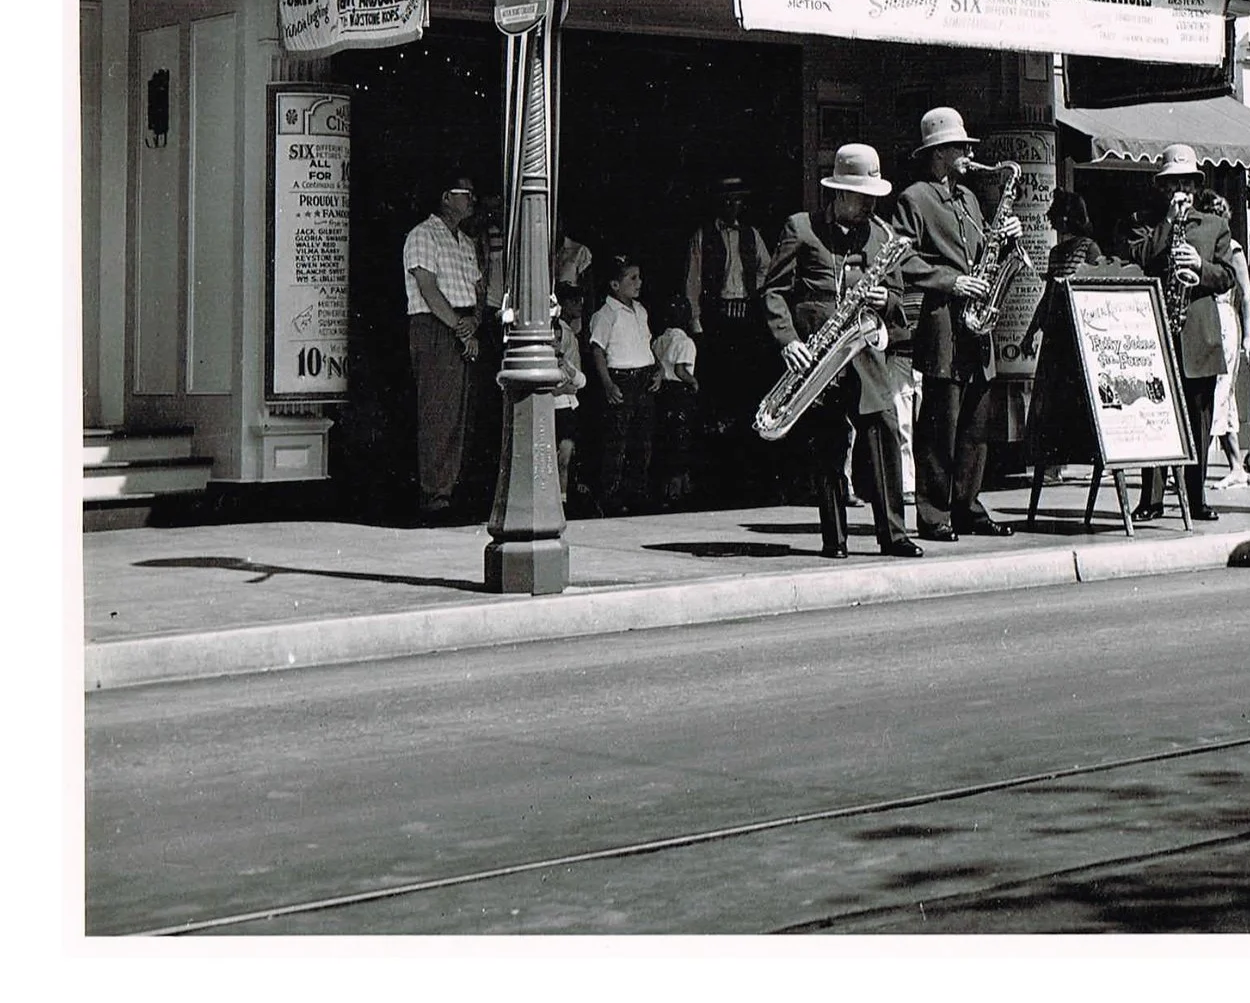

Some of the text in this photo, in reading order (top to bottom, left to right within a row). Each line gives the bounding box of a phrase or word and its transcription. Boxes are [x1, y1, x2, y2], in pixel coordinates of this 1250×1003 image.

[289, 143, 315, 160] SIX
[309, 159, 331, 168] ALL
[308, 171, 332, 180] FOR
[293, 180, 300, 189] A
[1032, 185, 1050, 193] FOR
[299, 194, 340, 207] PROUDLY
[1032, 193, 1050, 202] ALL
[1016, 285, 1043, 294] TREAT
